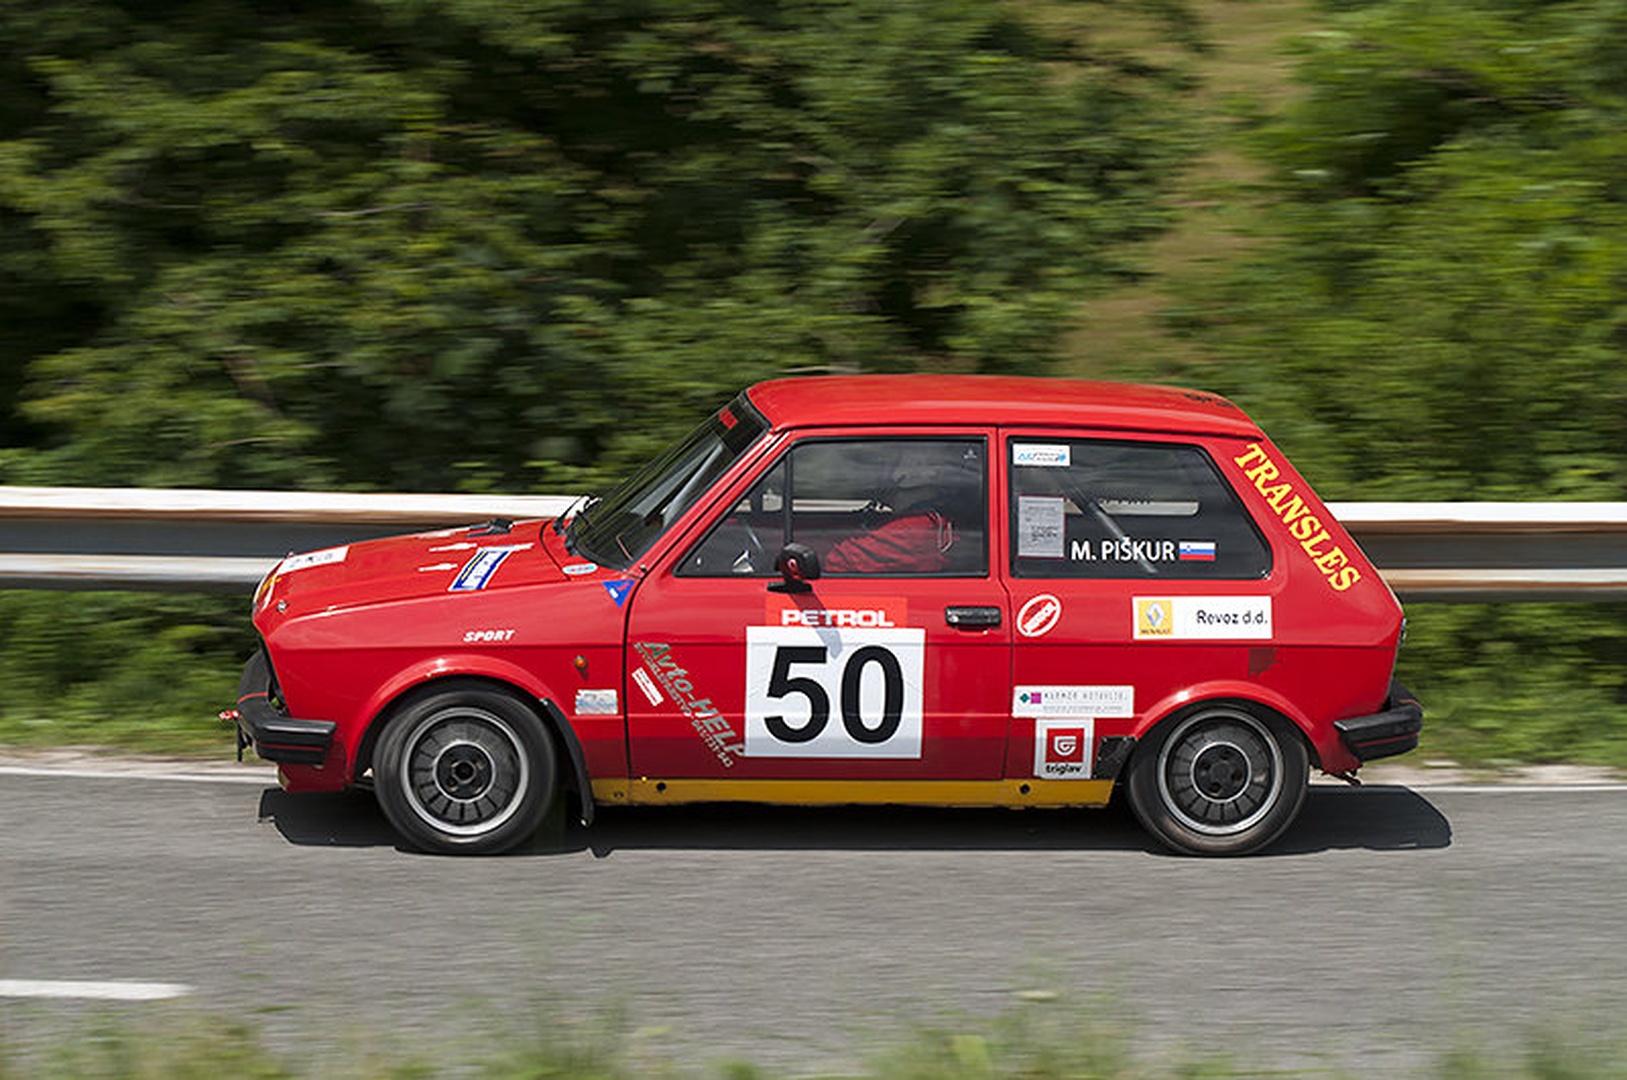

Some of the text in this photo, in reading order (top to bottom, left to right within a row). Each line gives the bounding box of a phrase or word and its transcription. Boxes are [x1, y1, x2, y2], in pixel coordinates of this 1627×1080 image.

[1234, 442, 1361, 591] TRANSLES
[1071, 536, 1175, 561] M. PIŠKUR
[781, 609, 895, 627] PETROL
[1196, 609, 1268, 625] Revoz d.d.
[463, 629, 516, 643] SPORT
[641, 641, 747, 757] Avto-HELP
[764, 645, 904, 743] 50
[1045, 763, 1082, 776] triglav
